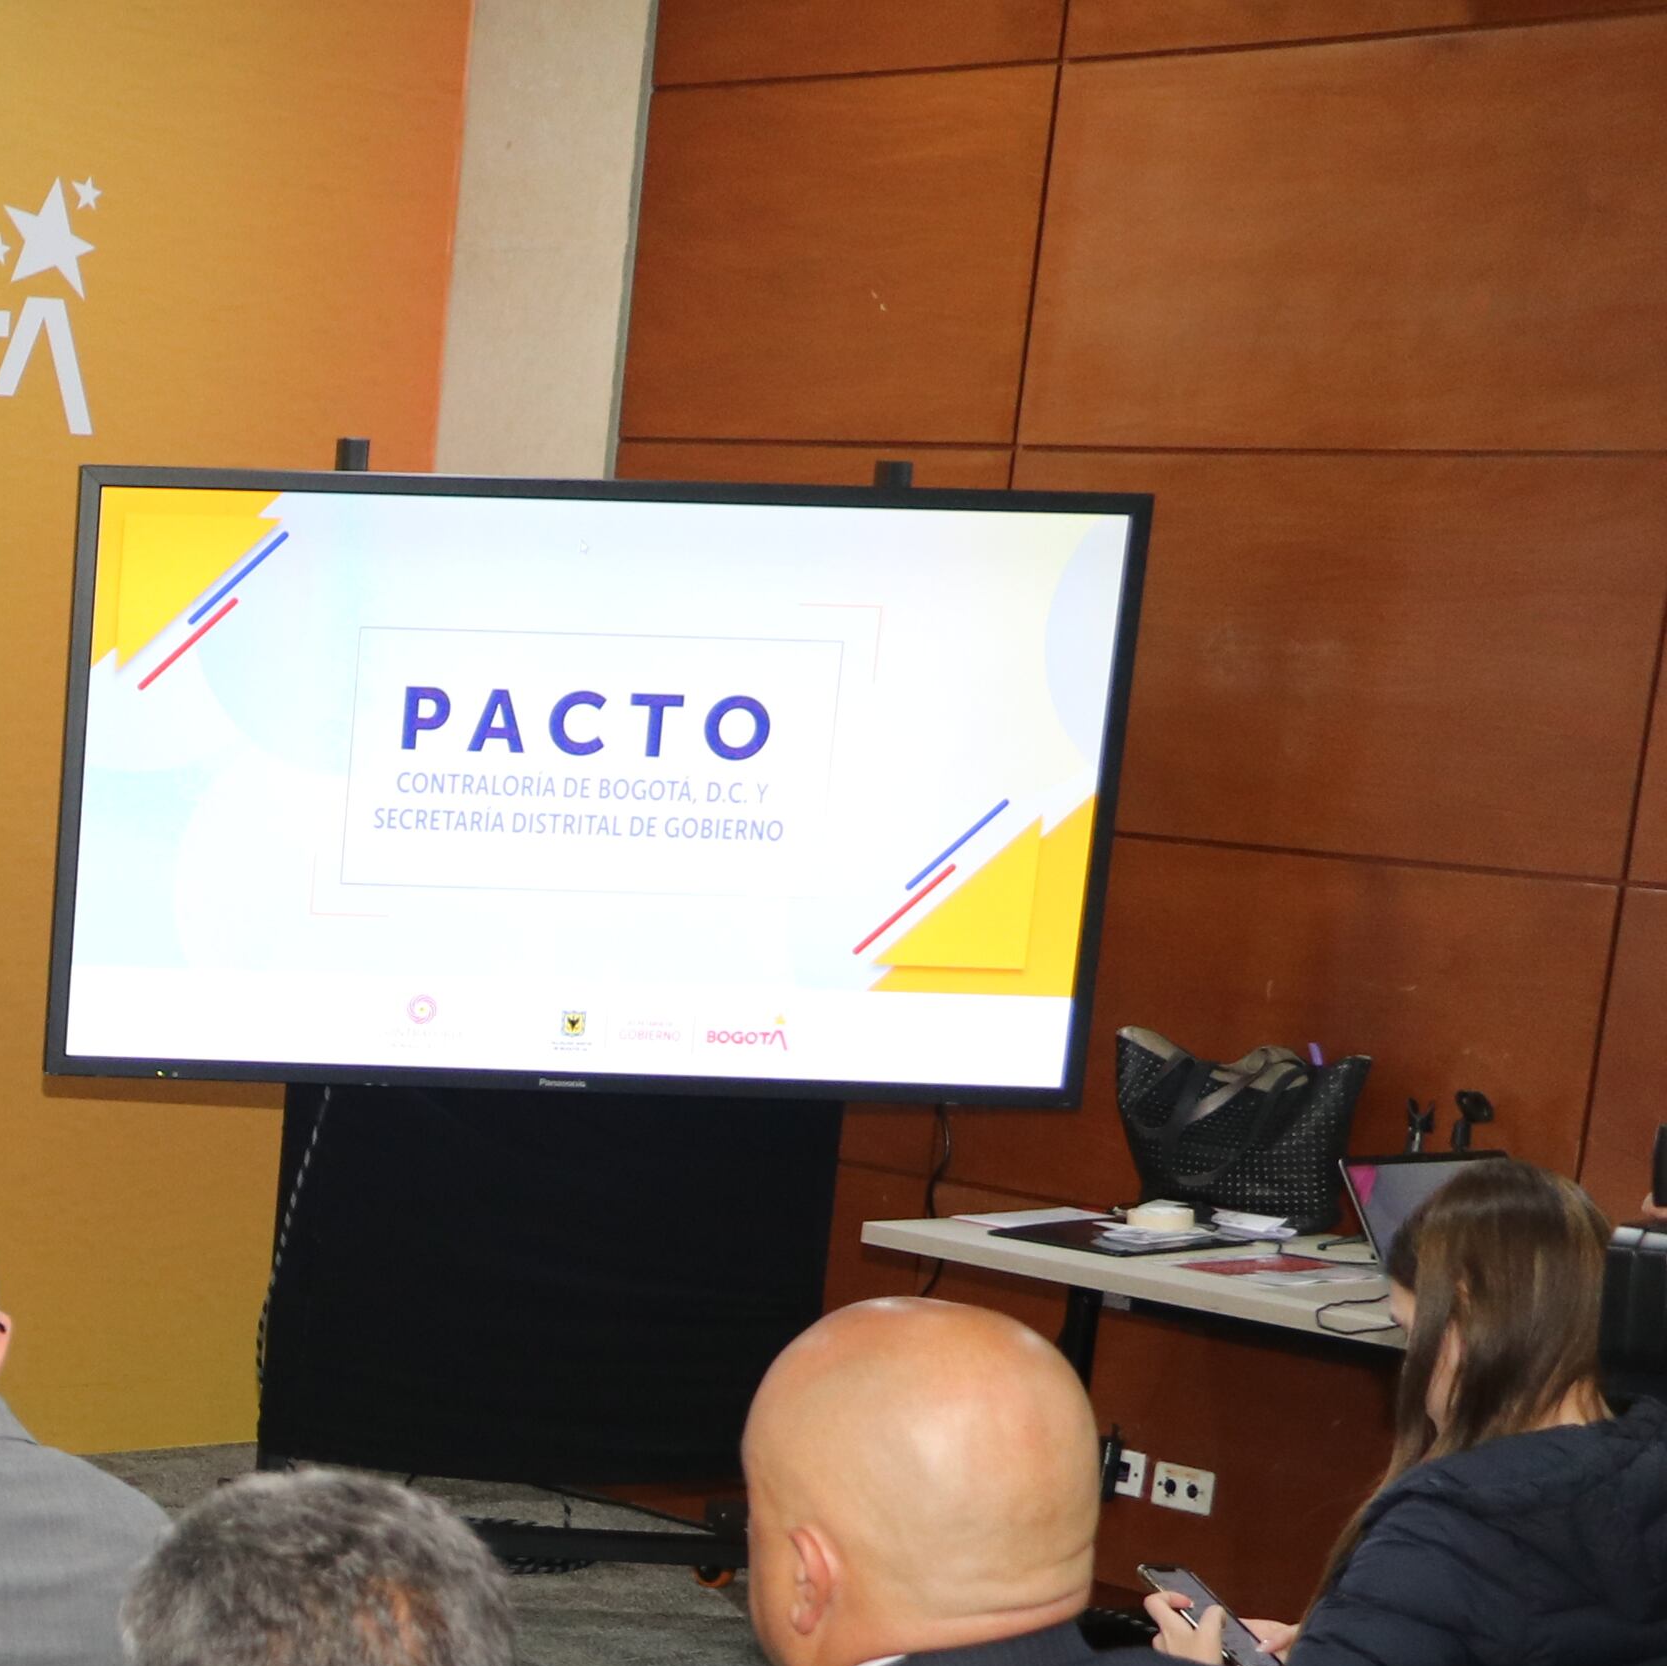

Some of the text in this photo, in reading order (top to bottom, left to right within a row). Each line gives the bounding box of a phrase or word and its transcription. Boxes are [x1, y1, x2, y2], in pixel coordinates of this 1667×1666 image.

[401, 686, 771, 761] PACTO
[396, 771, 769, 804] CONTRALORÍA DE BOGOTÁ, D.C. Y
[373, 805, 784, 842] SECRETARÍA DISTRITAL DE GOBIERNO
[539, 1078, 586, 1088] Panasonic
